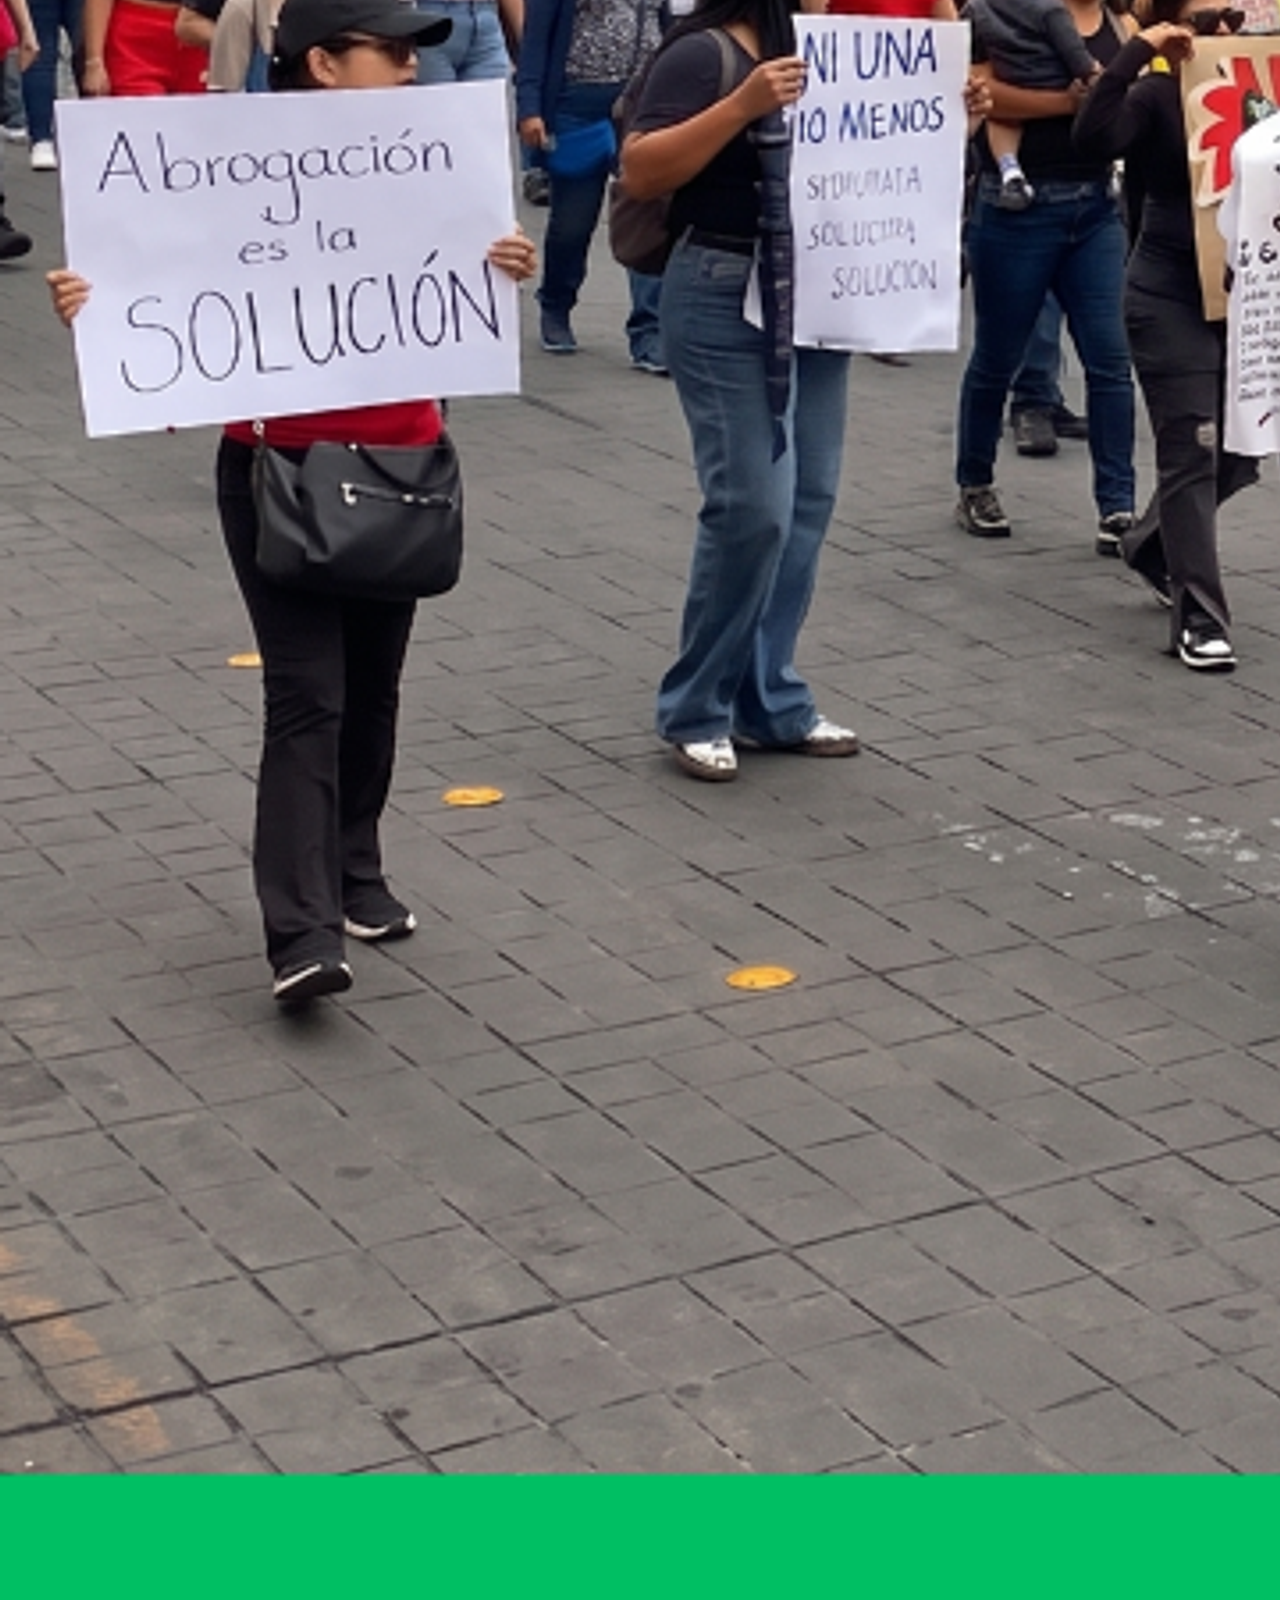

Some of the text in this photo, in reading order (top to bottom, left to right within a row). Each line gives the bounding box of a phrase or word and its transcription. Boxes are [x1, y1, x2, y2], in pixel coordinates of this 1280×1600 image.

[854, 27, 938, 80] UNA
[838, 96, 946, 145] MENOS
[98, 128, 454, 226] Abrogación
[238, 219, 358, 266] es la
[120, 248, 502, 393] SOLUCIÓN
